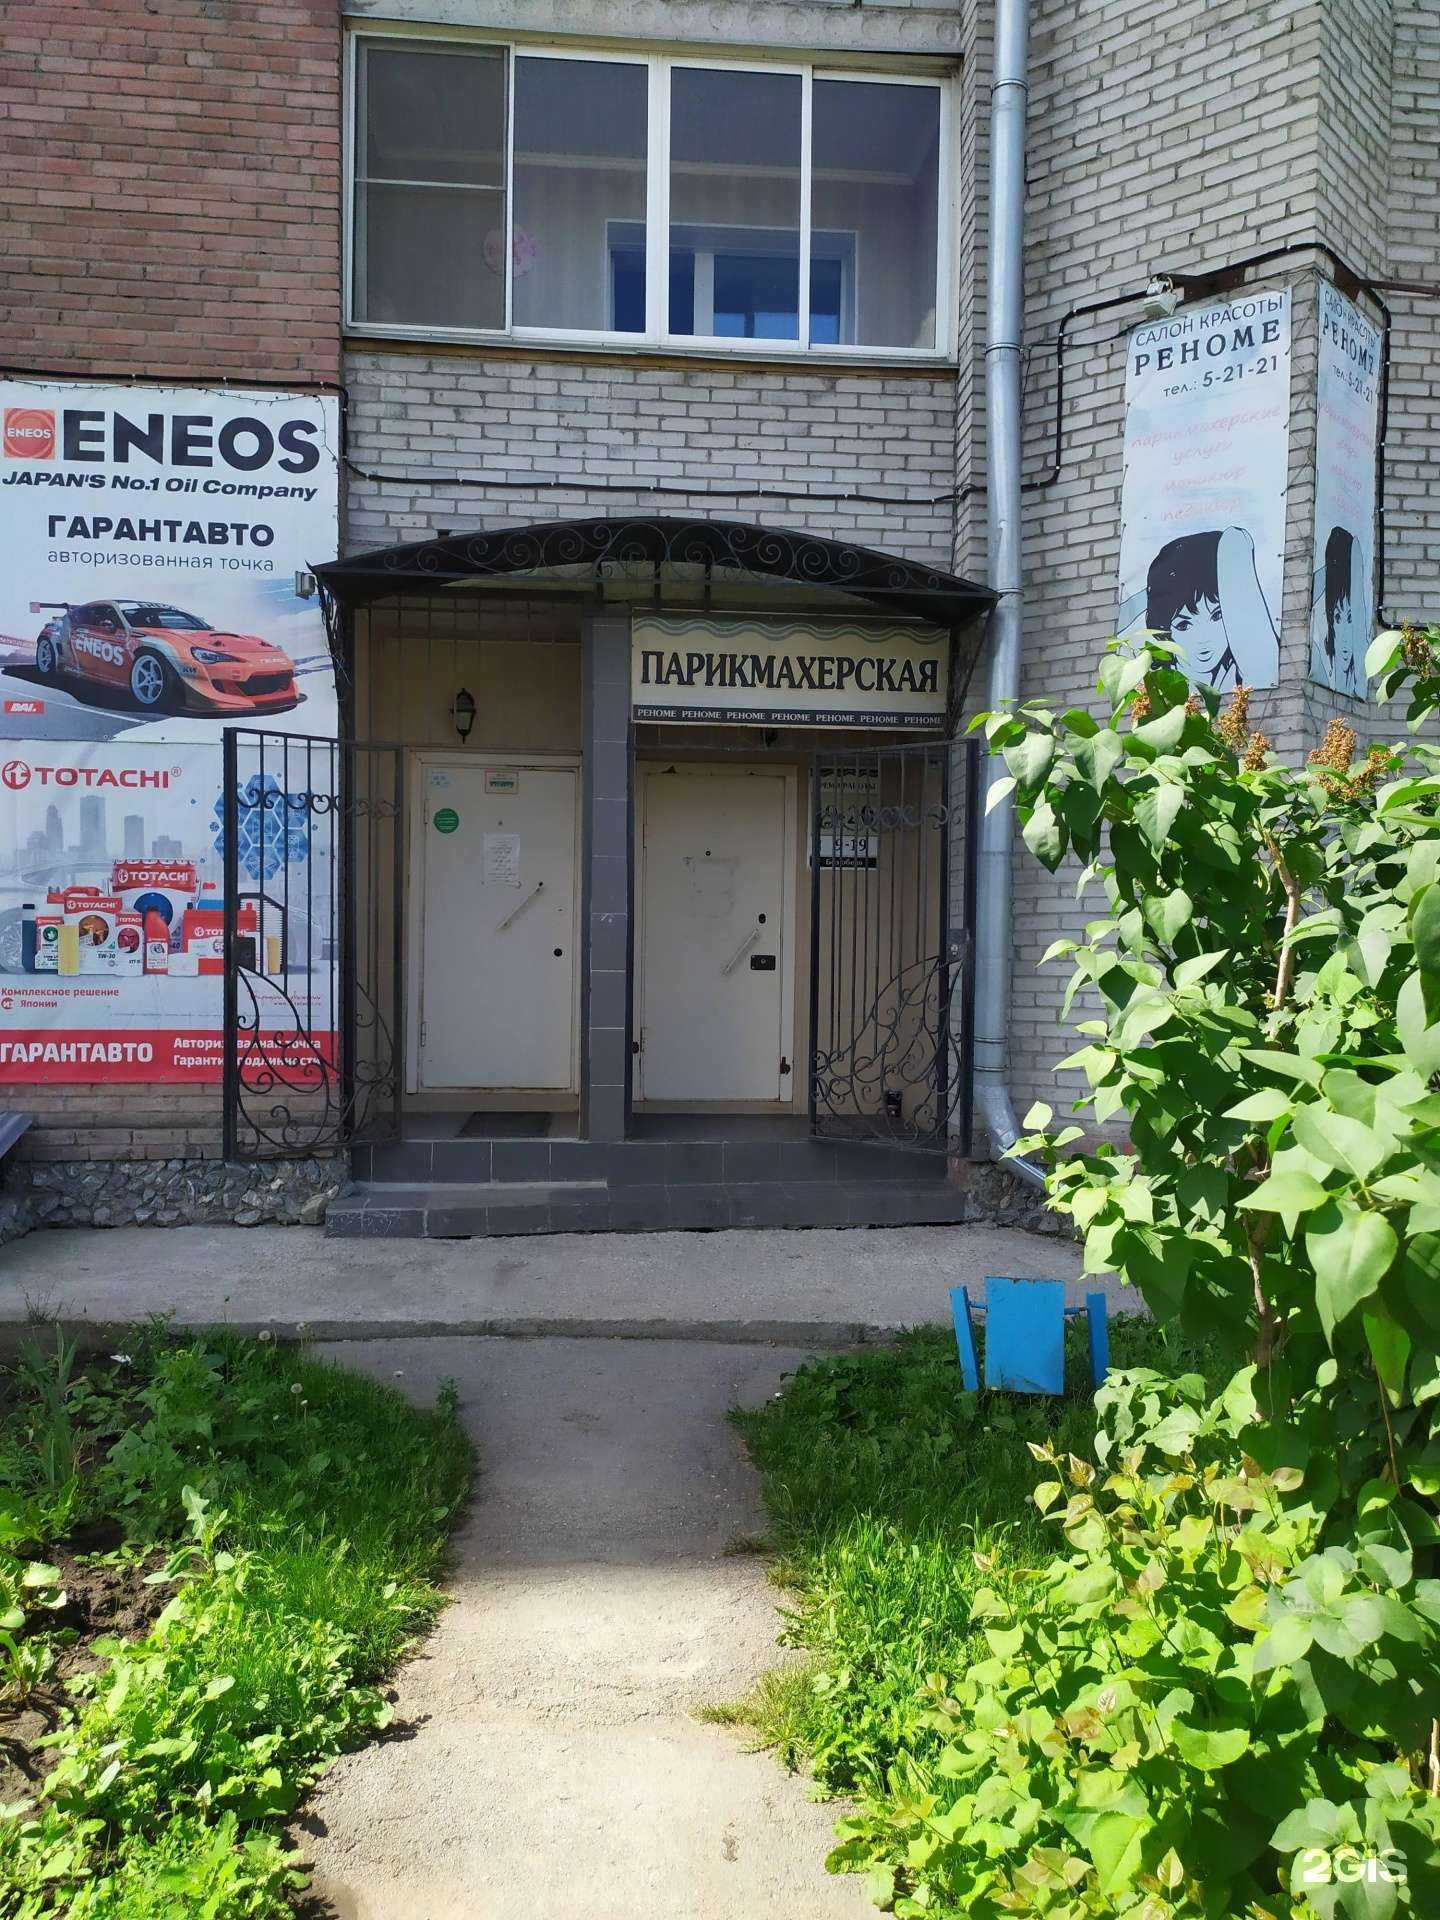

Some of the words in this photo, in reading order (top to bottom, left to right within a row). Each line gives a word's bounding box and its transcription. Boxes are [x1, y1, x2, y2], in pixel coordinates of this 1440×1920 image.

[1136, 318, 1194, 347] САЛОН
[1199, 295, 1283, 330] КРАСОТЫ
[1134, 318, 1281, 377] РЕНОМЕ
[1202, 355, 1278, 388] 5-21-21
[7, 427, 53, 439] ENEOS
[63, 409, 321, 474] ENEOS
[2, 471, 106, 489] JAPAN'S
[111, 476, 159, 491] No.1
[165, 477, 199, 493] Oil
[202, 479, 318, 502] Company
[48, 514, 274, 548] ГАРАНТАВТО
[47, 550, 213, 570] авторизованная
[220, 557, 274, 572] точка
[75, 637, 124, 666] ENEOS
[641, 650, 939, 693] ПАРИКМАХЕРСКАЯ
[638, 708, 677, 718] РЕНОМЕ
[682, 710, 722, 719] РЕНОМЕ
[726, 711, 766, 720] РЕНОМЕ
[771, 713, 811, 722] РЕНОМЕ
[815, 713, 855, 723] РЕНОМЕ
[860, 715, 899, 724] РЕНОМЕ
[904, 716, 943, 725] РЕНОМЕ
[35, 767, 169, 788] TOTACHI
[129, 871, 188, 882] TOTACHI
[1, 987, 71, 997] Комплексное
[73, 988, 119, 998] решение
[20, 1000, 58, 1008] Японии
[0, 1042, 153, 1063] ГАРАНТАВТО
